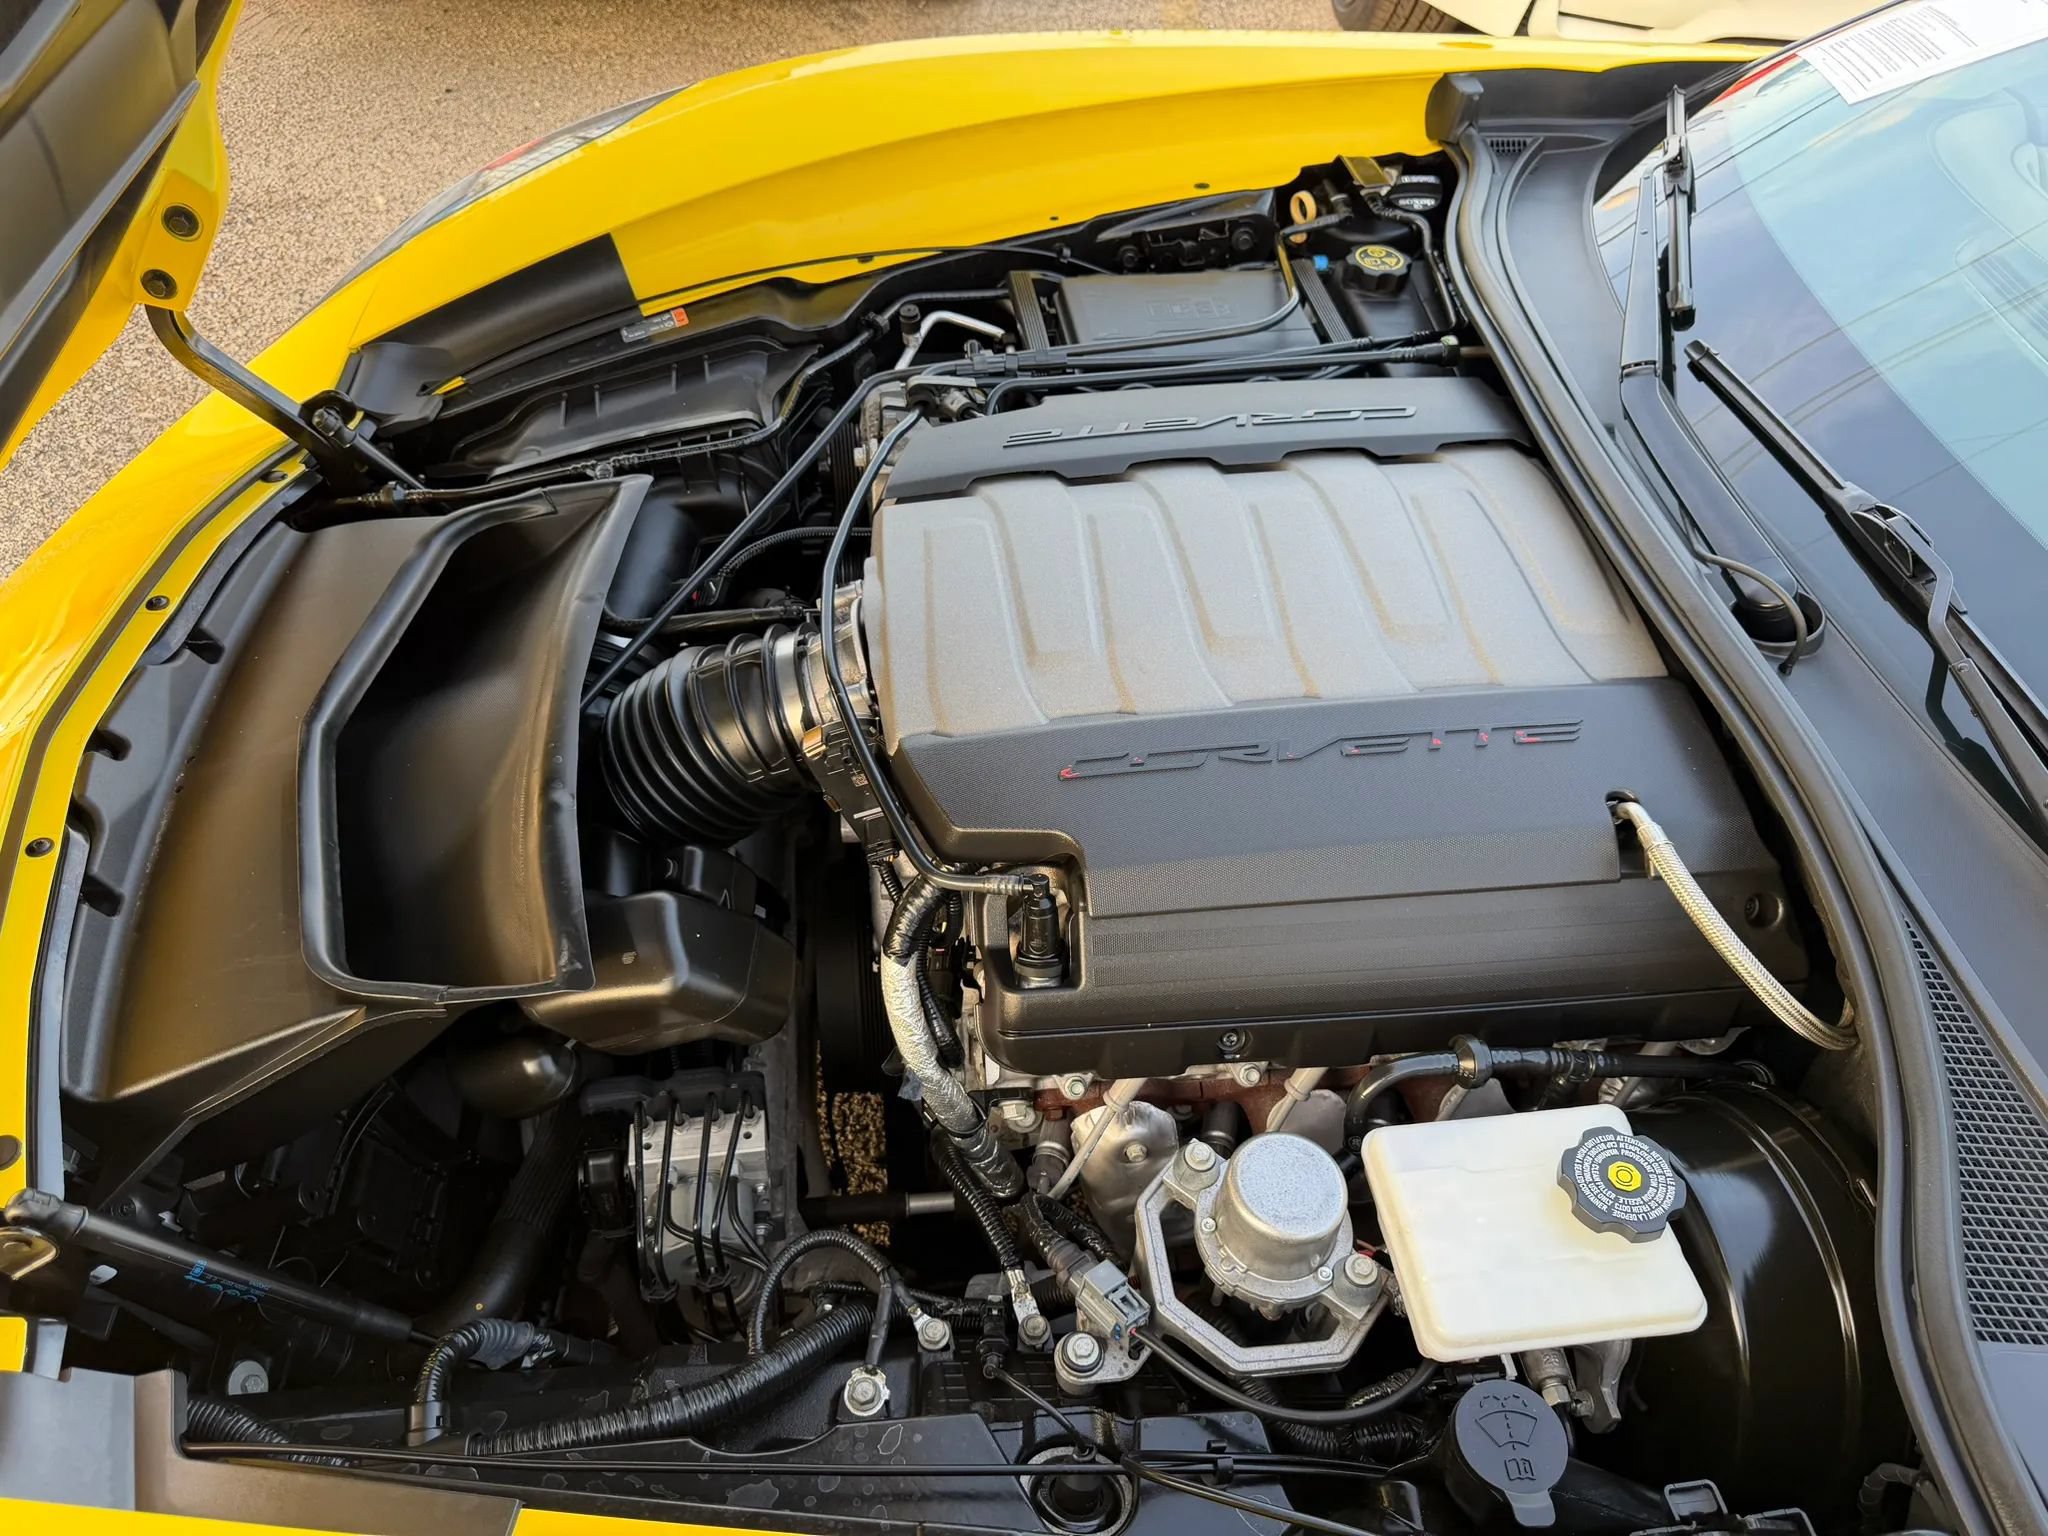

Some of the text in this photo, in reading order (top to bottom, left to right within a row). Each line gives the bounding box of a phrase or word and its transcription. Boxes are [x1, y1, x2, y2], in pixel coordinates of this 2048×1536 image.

[1003, 406, 1417, 447] CORVETTE
[1058, 719, 1583, 780] CORVETTE
[1584, 1136, 1601, 1149] FLUID
[1598, 1134, 1615, 1142] DOT3
[1587, 1142, 1607, 1159] BEFORE
[1606, 1141, 1618, 1149] CAP
[1576, 1145, 1589, 1160] FROM
[1650, 1151, 1673, 1177] NETTOYER
[1651, 1162, 1664, 1175] QUE
[1574, 1163, 1585, 1184] SEALED
[1591, 1163, 1602, 1182] CLEAN
[1658, 1174, 1666, 1184] DU
[1666, 1178, 1675, 1186] LE
[1588, 1182, 1600, 1196] USE
[1595, 1181, 1616, 1200] FILLER
[1580, 1183, 1608, 1213] CONTAINER.
[1597, 1193, 1614, 1206] ONLY
[1648, 1200, 1658, 1209] DE
[1614, 1203, 1631, 1212] DOT3
[1637, 1213, 1649, 1221] LA
